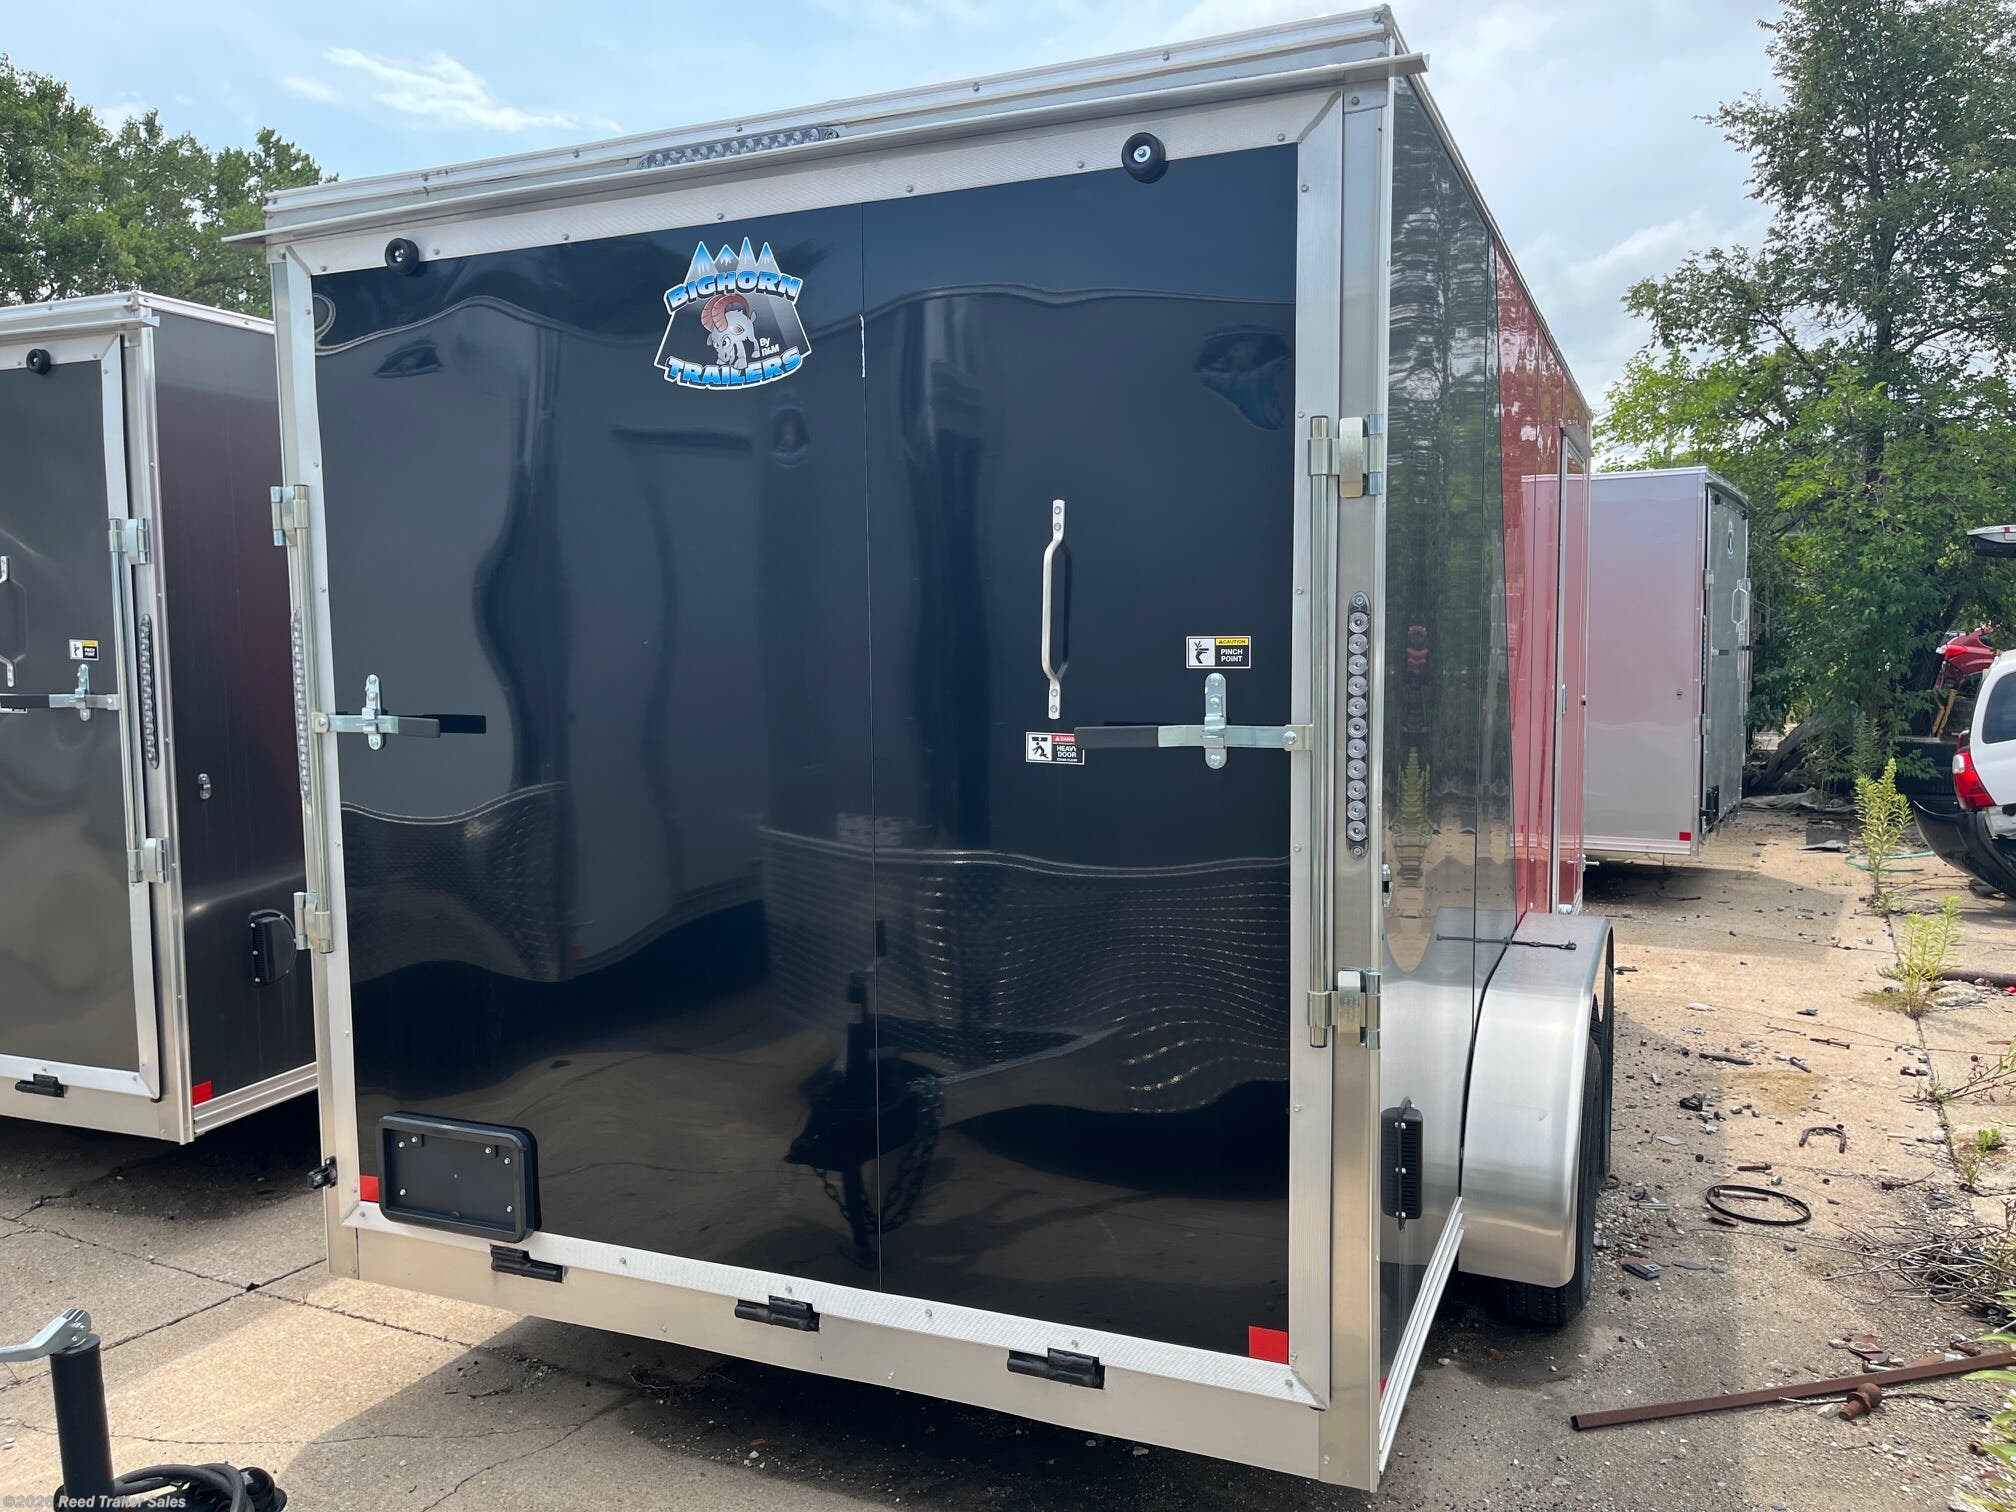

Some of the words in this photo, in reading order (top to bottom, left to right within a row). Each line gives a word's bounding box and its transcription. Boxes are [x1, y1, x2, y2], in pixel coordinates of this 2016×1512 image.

[668, 271, 801, 312] BIGHORN
[759, 337, 770, 347] By
[761, 343, 780, 356] R&M
[666, 346, 802, 385] TRAILERS
